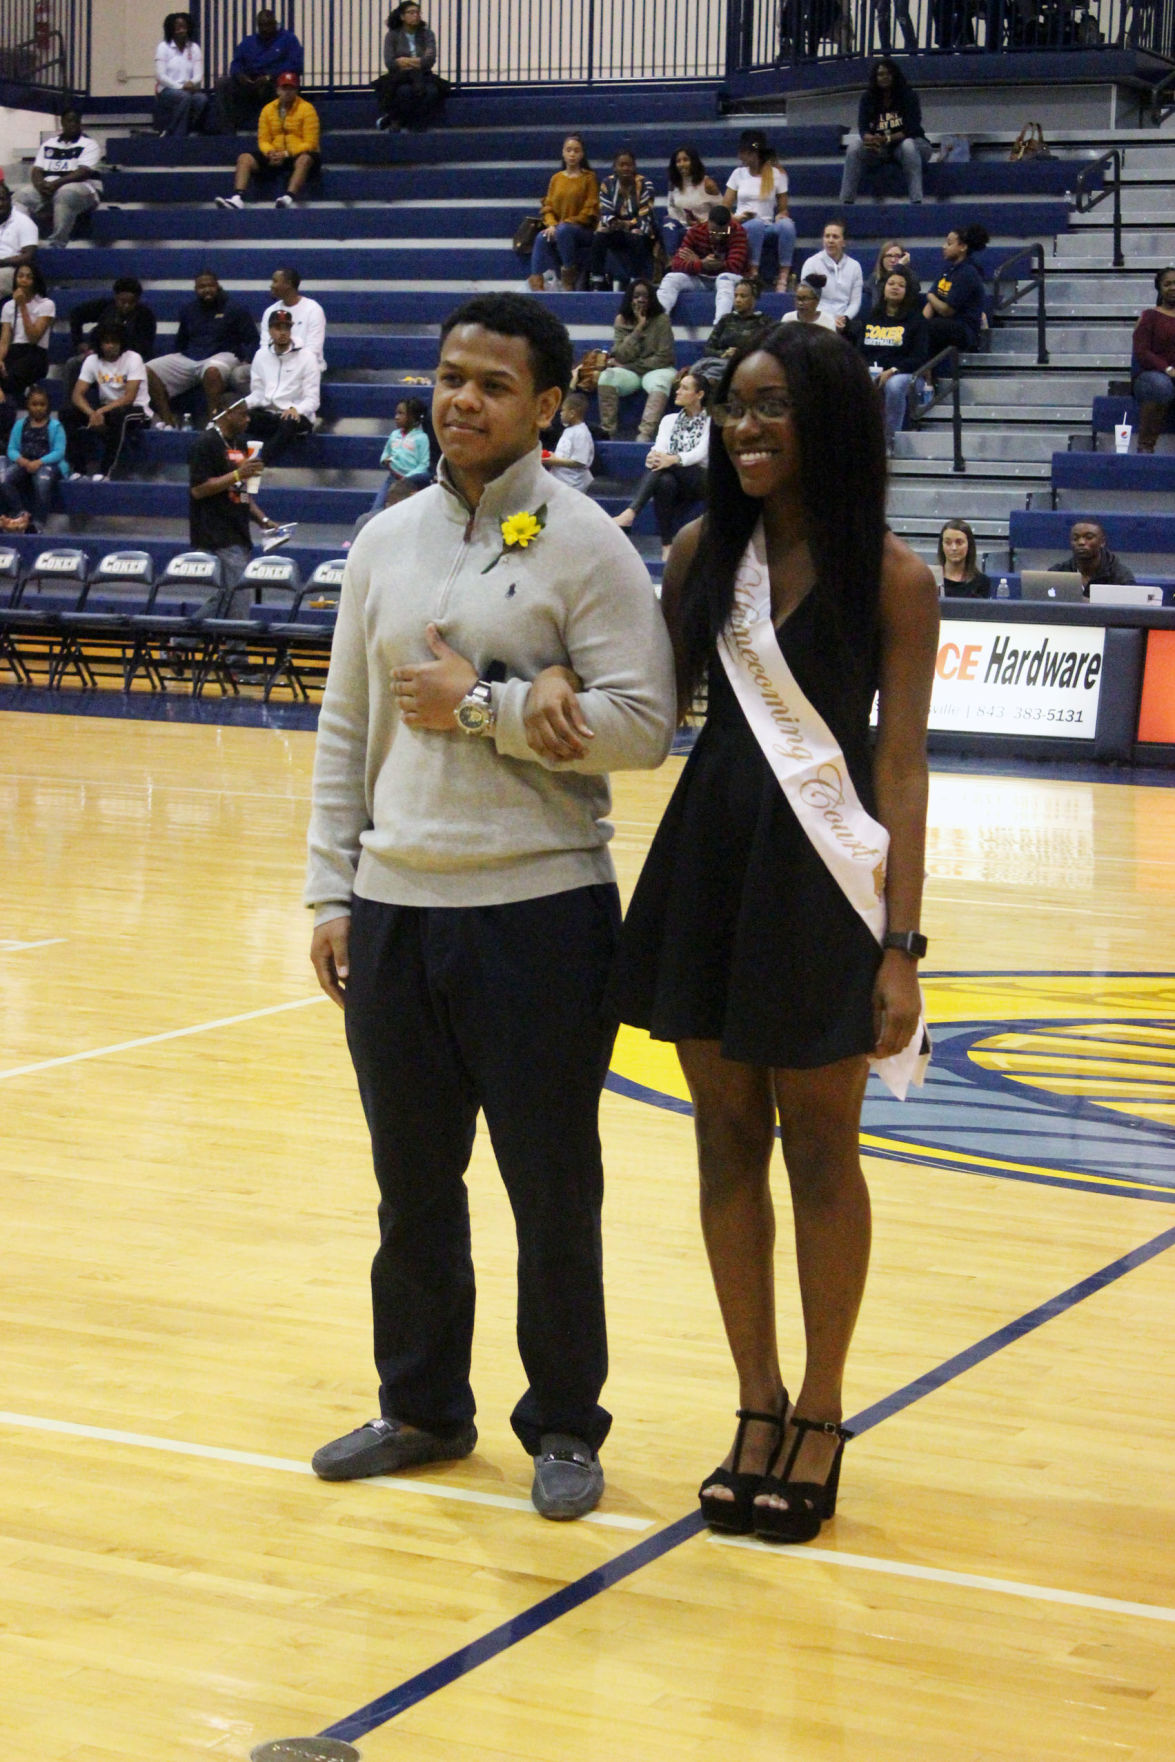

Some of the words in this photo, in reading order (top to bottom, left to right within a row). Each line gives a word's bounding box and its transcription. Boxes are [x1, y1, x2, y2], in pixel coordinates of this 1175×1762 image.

[100, 555, 148, 574] COKER
[167, 557, 216, 577] COKER
[244, 560, 293, 580] COKER
[934, 642, 983, 681] CE
[984, 635, 1102, 690] Hardware
[799, 763, 881, 862] Court
